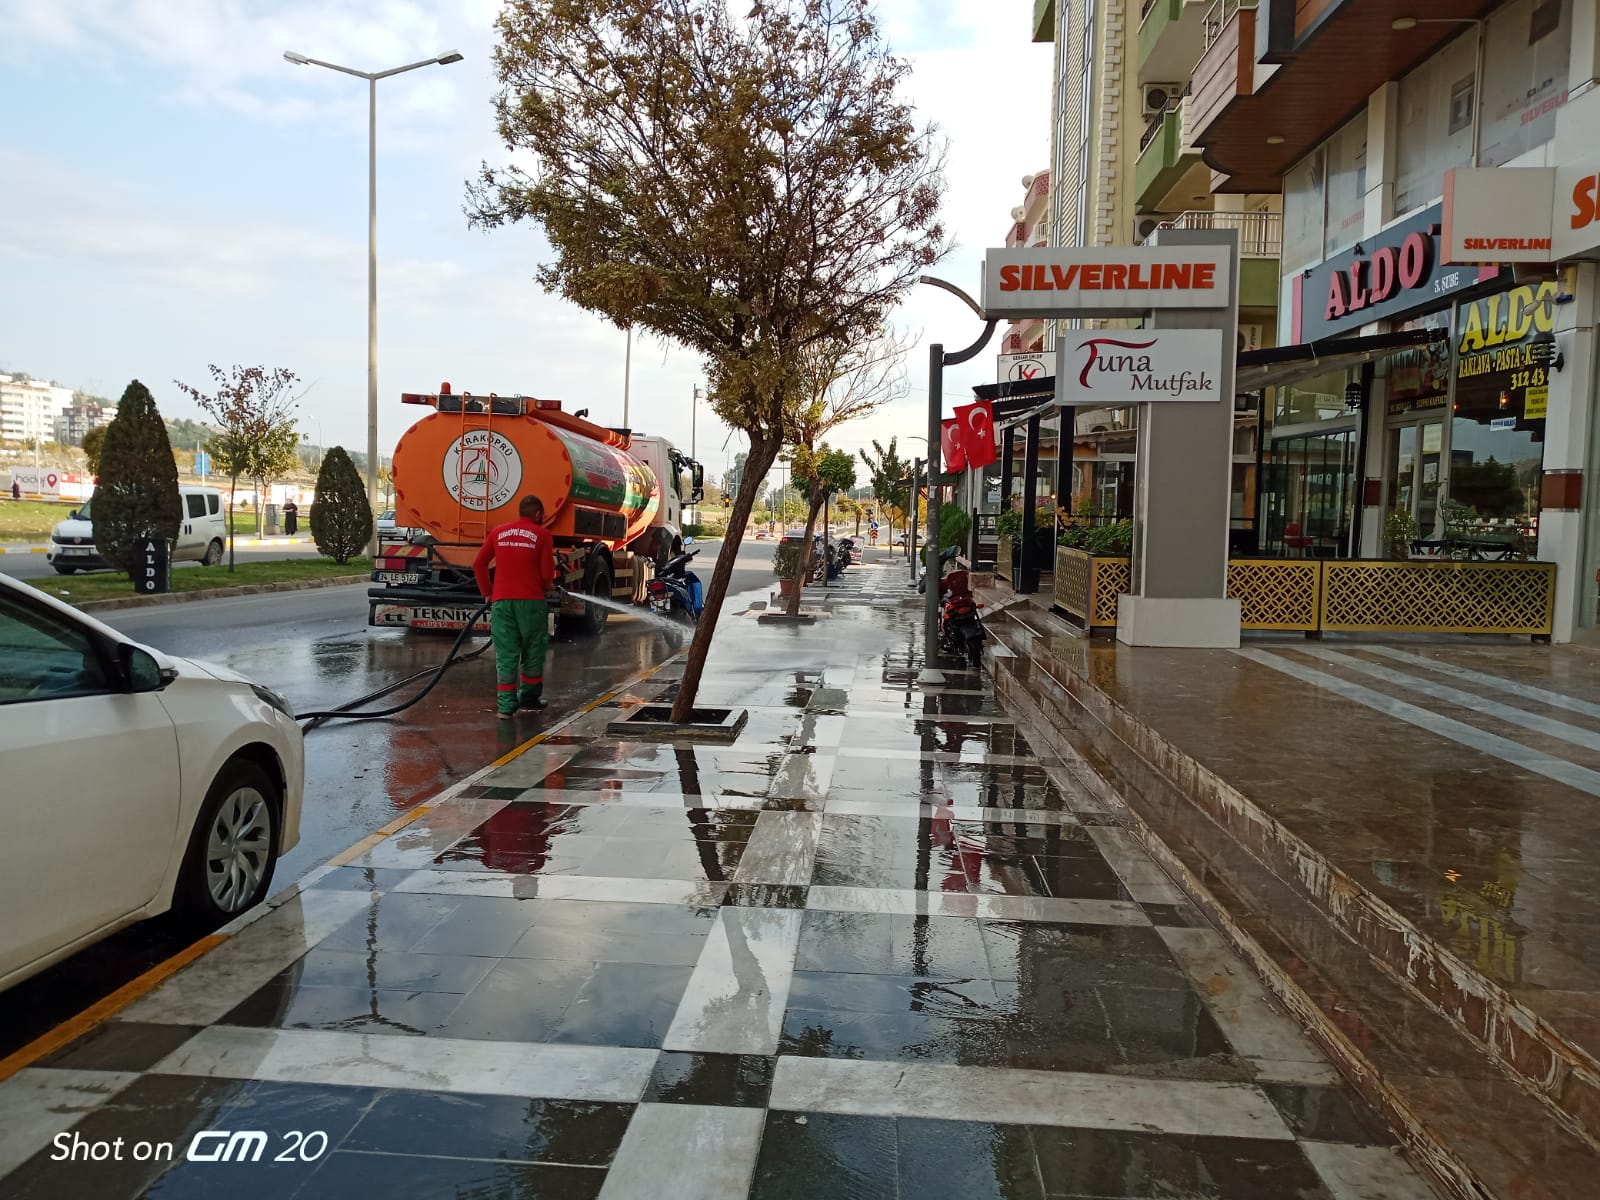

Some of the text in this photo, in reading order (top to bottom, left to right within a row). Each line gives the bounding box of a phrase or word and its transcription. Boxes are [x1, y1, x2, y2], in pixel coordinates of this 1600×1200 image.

[1571, 172, 1600, 230] S
[1000, 263, 1216, 292] SILVERLINE
[1324, 232, 1426, 320] ALDO
[1459, 281, 1558, 354] ALDO
[1075, 338, 1159, 389] Tuna
[1458, 352, 1491, 379] BAKLAVA
[1496, 346, 1520, 372] PASTA
[1510, 370, 1530, 390] 312
[1130, 370, 1213, 396] Mutfak
[451, 484, 511, 507] BLEDYESİ
[145, 542, 156, 590] ALDO
